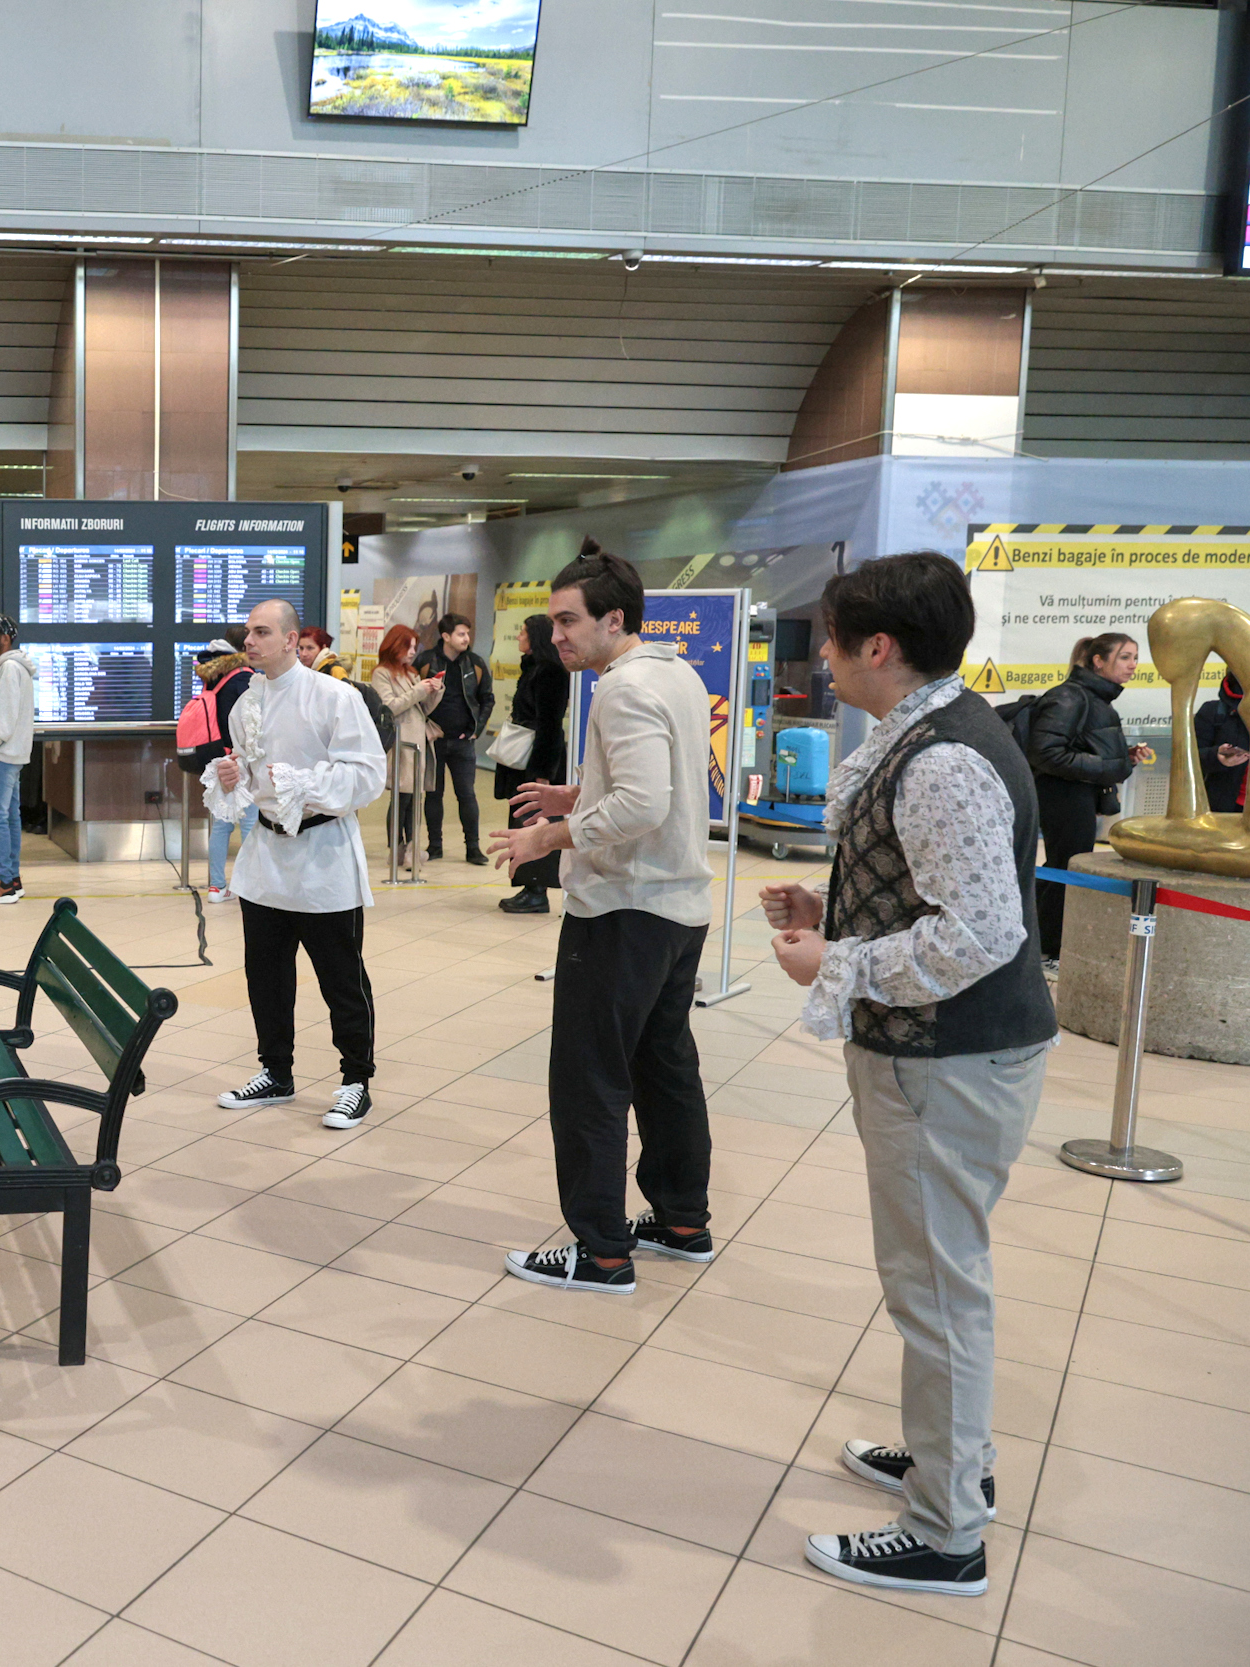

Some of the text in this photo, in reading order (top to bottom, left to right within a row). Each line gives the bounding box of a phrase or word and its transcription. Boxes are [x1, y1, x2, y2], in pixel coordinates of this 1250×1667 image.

[20, 518, 124, 530] INFORMATII ZBORURI
[195, 519, 304, 532] FLIGHTS INFORMATION
[1012, 548, 1053, 563] Benzi
[1057, 548, 1106, 567] bagaje
[1110, 549, 1124, 563] în
[1129, 552, 1177, 567] proces
[1182, 549, 1200, 564] de
[1040, 595, 1054, 607] Vă
[1058, 594, 1127, 610] mulțumim
[1128, 596, 1165, 611] pentru
[1001, 613, 1149, 627] și ne cerem scuze pentru
[1006, 671, 1054, 685] Baggage
[1201, 669, 1225, 680] izati
